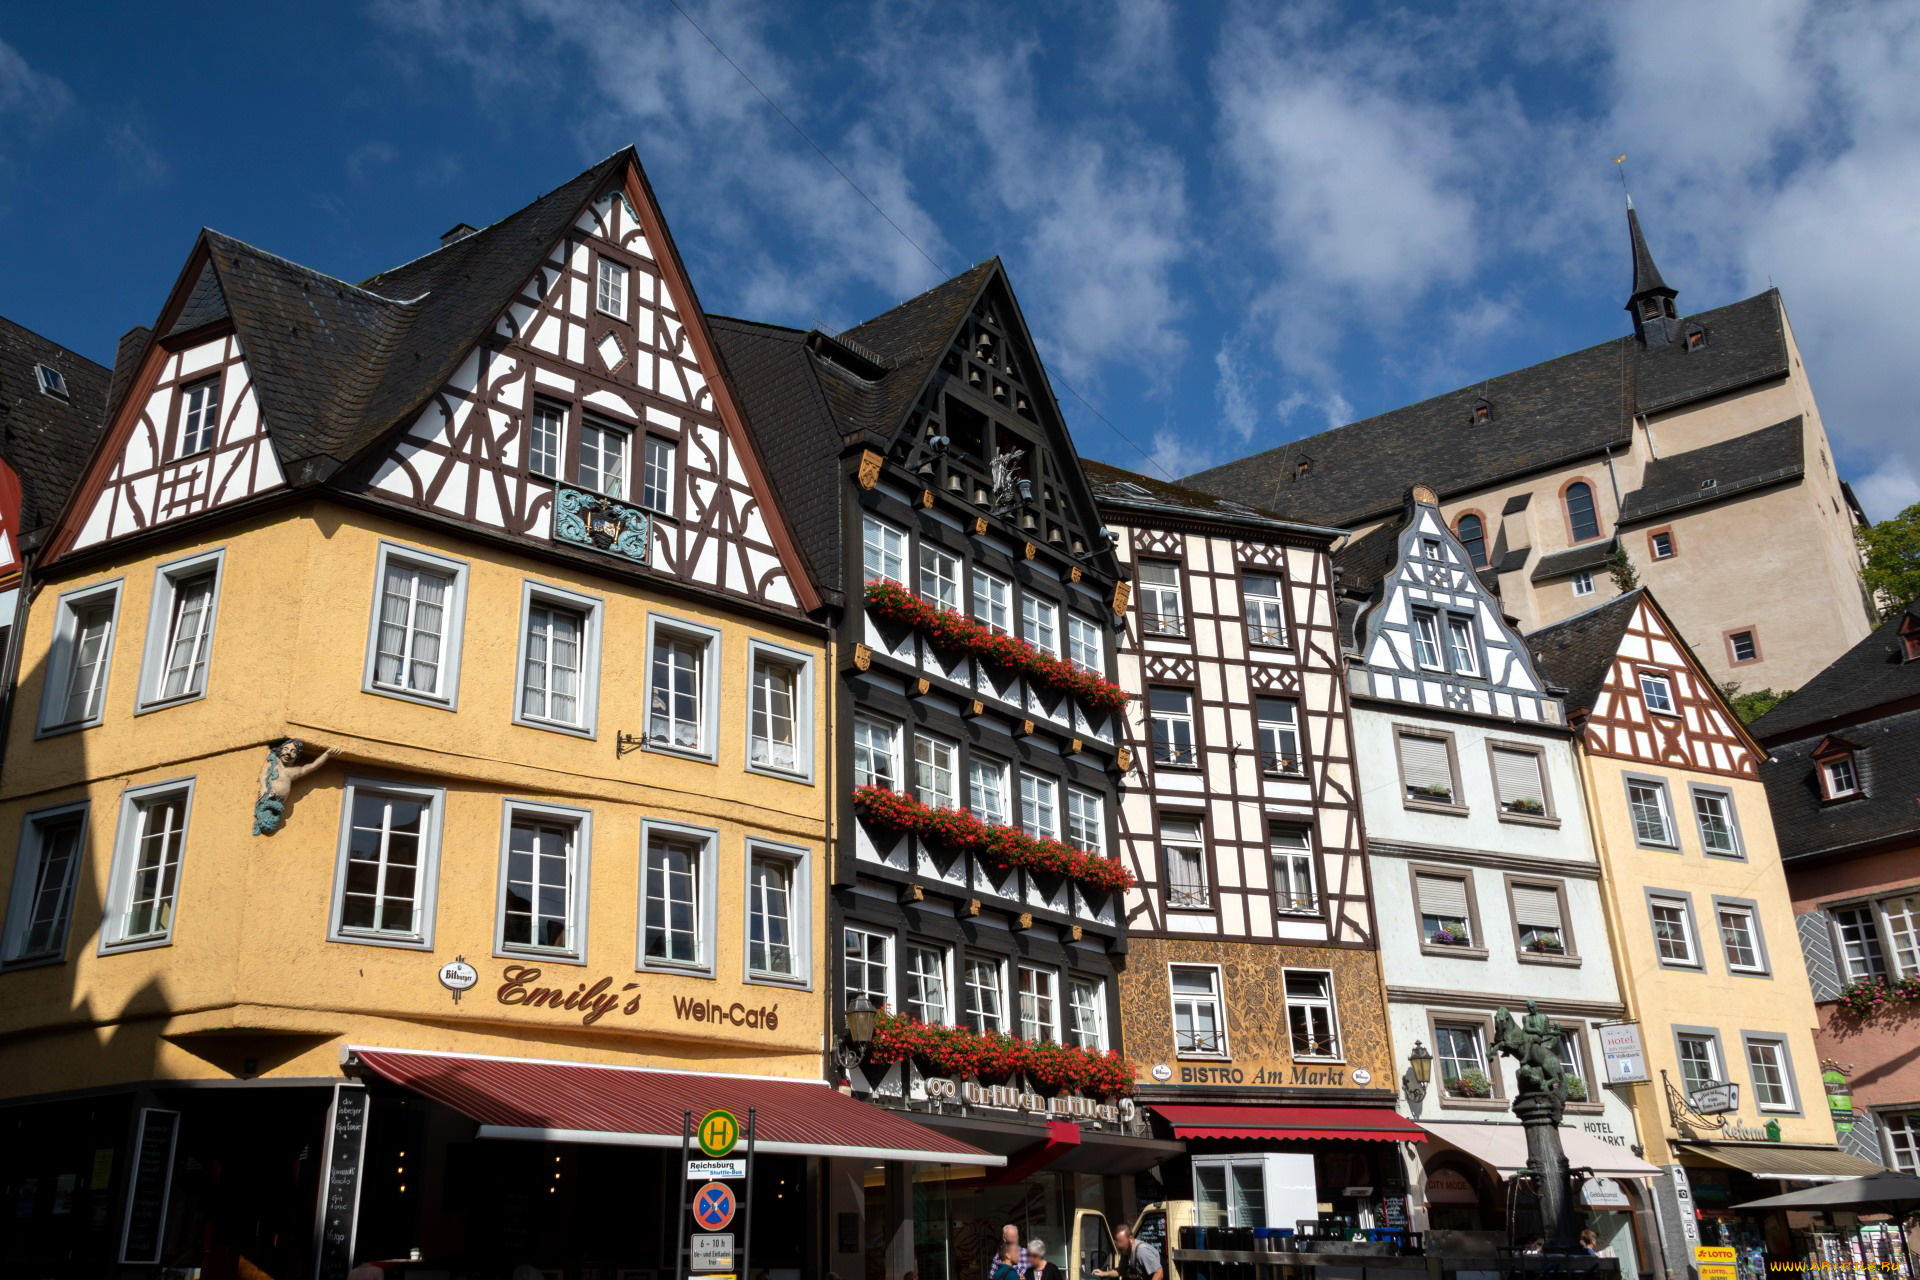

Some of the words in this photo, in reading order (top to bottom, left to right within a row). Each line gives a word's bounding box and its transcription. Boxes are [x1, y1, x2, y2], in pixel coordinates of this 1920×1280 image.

[445, 969, 472, 982] Bitburger
[673, 995, 778, 1031] Wein-Café
[1181, 1066, 1244, 1084] BISTRO
[1251, 1065, 1284, 1085] Am
[1289, 1066, 1344, 1086] Markt
[1611, 1074, 1645, 1082] Geldautomat
[962, 1081, 1045, 1112] brillen
[709, 1120, 727, 1146] H
[1583, 1122, 1613, 1133] HOTEL
[1721, 1118, 1768, 1140] Reform
[1593, 1135, 1625, 1146] ARKT
[690, 1161, 734, 1171] Reichsburg
[1429, 1180, 1444, 1190] CITY
[1446, 1181, 1467, 1190] MODE
[1590, 1191, 1618, 1199] Geldautomat
[700, 1239, 705, 1248] 6
[712, 1239, 720, 1248] 10
[721, 1238, 725, 1247] h
